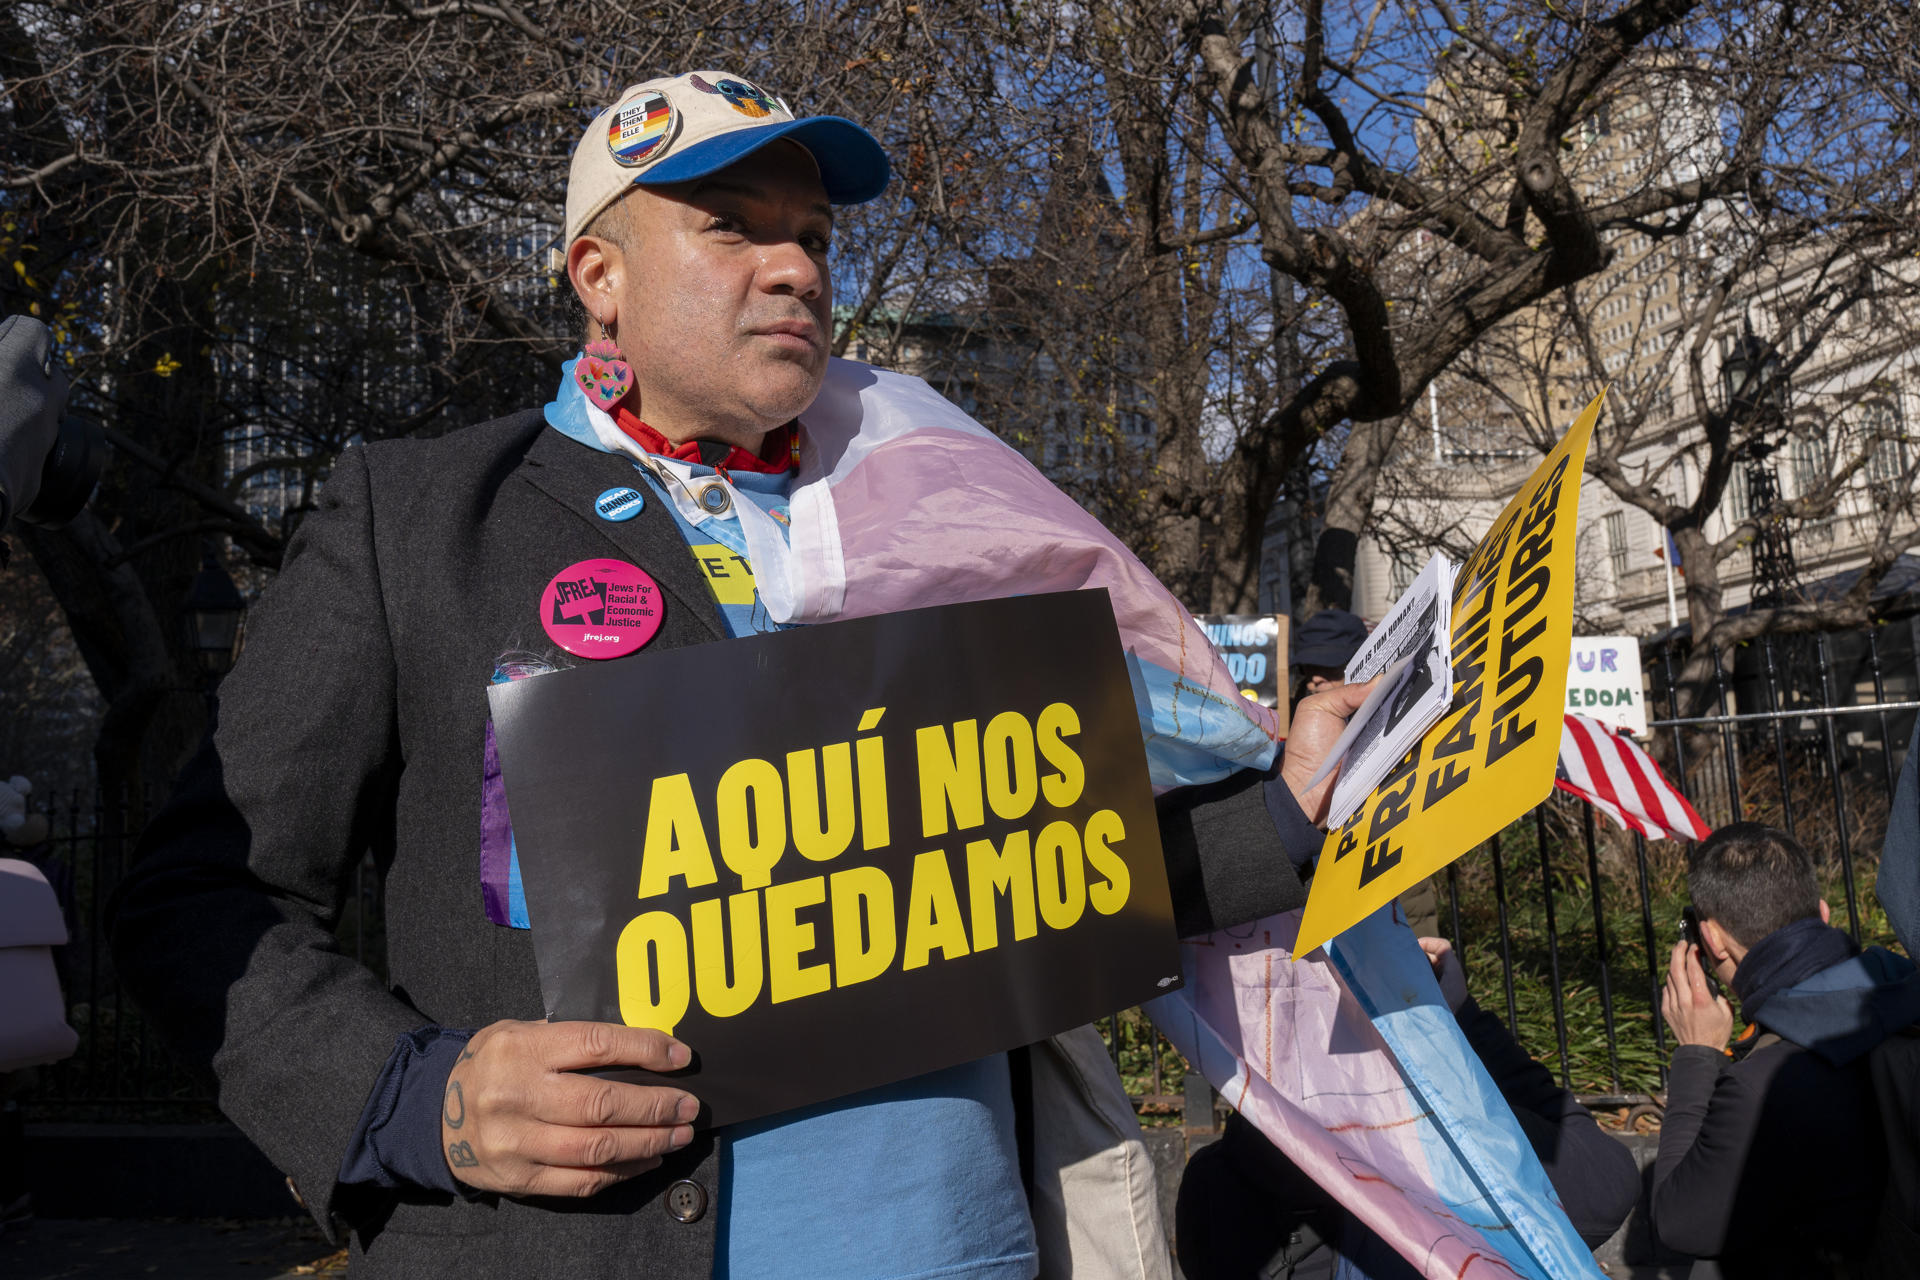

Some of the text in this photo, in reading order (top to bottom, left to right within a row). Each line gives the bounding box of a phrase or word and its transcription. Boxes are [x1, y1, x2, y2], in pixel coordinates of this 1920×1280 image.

[621, 105, 642, 119] THEY
[621, 115, 643, 129] THEM
[622, 126, 640, 139] ELLE
[599, 489, 629, 505] READ
[599, 491, 639, 514] BANNED
[608, 499, 641, 517] BOOKS
[556, 577, 599, 606] JFREJ
[608, 583, 652, 593] Jews For
[607, 594, 648, 604] Racial &
[607, 605, 654, 617] Economic
[1485, 454, 1570, 769] FUTURES
[606, 617, 641, 628] Justice
[583, 633, 620, 643] jfrej.org
[1365, 649, 1372, 664] IS
[1373, 632, 1387, 654] TOM
[1422, 506, 1521, 812] FAMILIES
[1570, 648, 1618, 672] UR
[1568, 687, 1633, 707] EDOM
[638, 702, 1085, 900] AQUÍ NOS
[617, 809, 1131, 1038] QUEDAMOS
